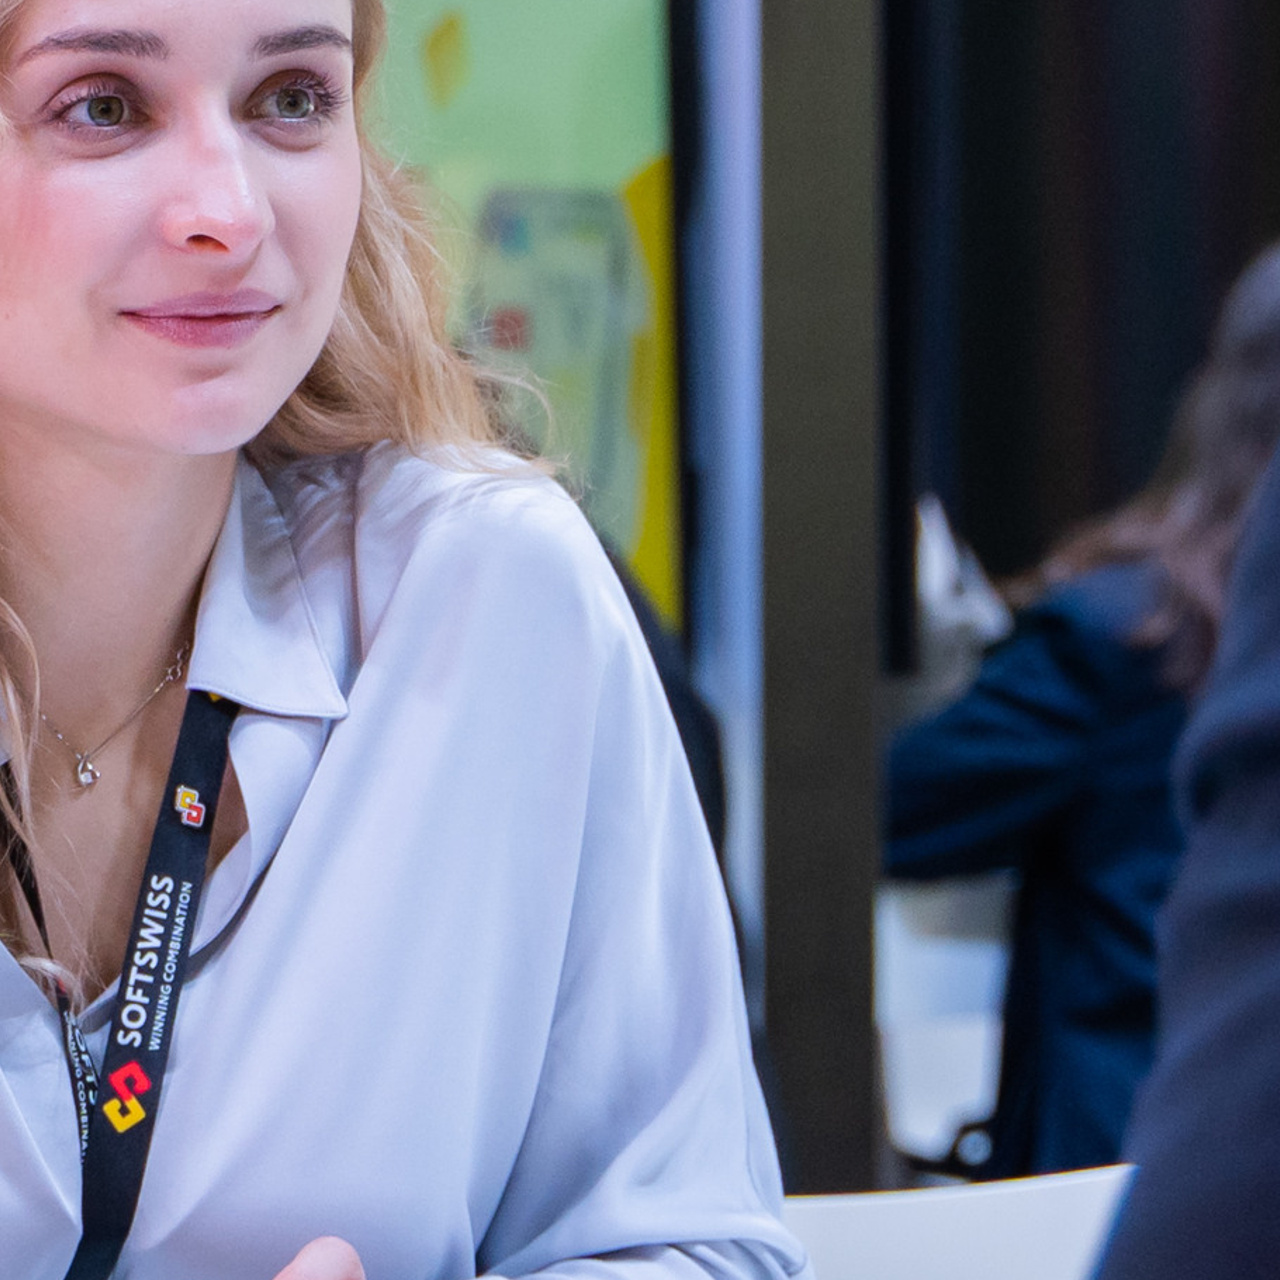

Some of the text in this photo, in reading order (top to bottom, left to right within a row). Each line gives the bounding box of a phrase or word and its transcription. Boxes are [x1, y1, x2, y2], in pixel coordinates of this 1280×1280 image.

[117, 874, 174, 1048] SOFTSWISS
[148, 881, 193, 1051] WINNING COMBINATION
